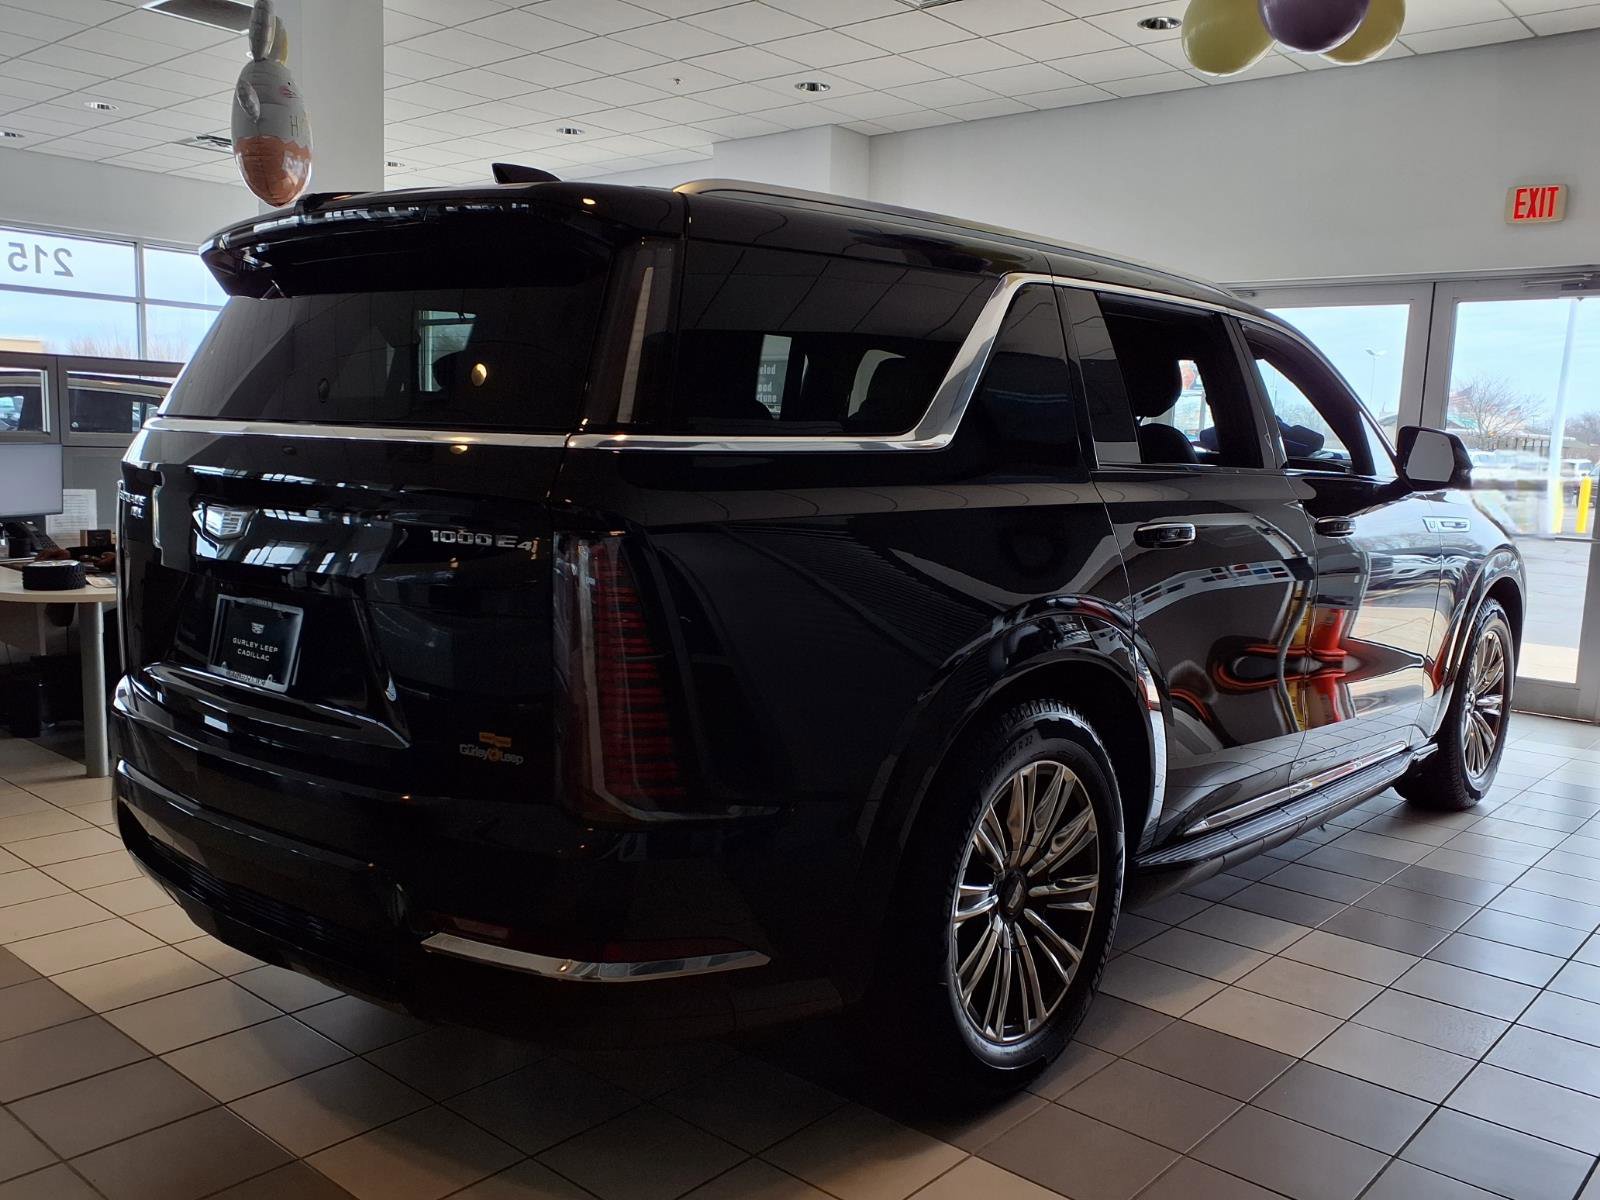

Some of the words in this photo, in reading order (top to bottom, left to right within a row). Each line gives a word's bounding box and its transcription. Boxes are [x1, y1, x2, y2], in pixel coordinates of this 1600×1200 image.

[1513, 186, 1559, 219] EXIT
[232, 637, 260, 649] GURLEY
[260, 644, 279, 653] LEEP
[237, 648, 271, 662] CADILLAC
[500, 751, 525, 766] Leep
